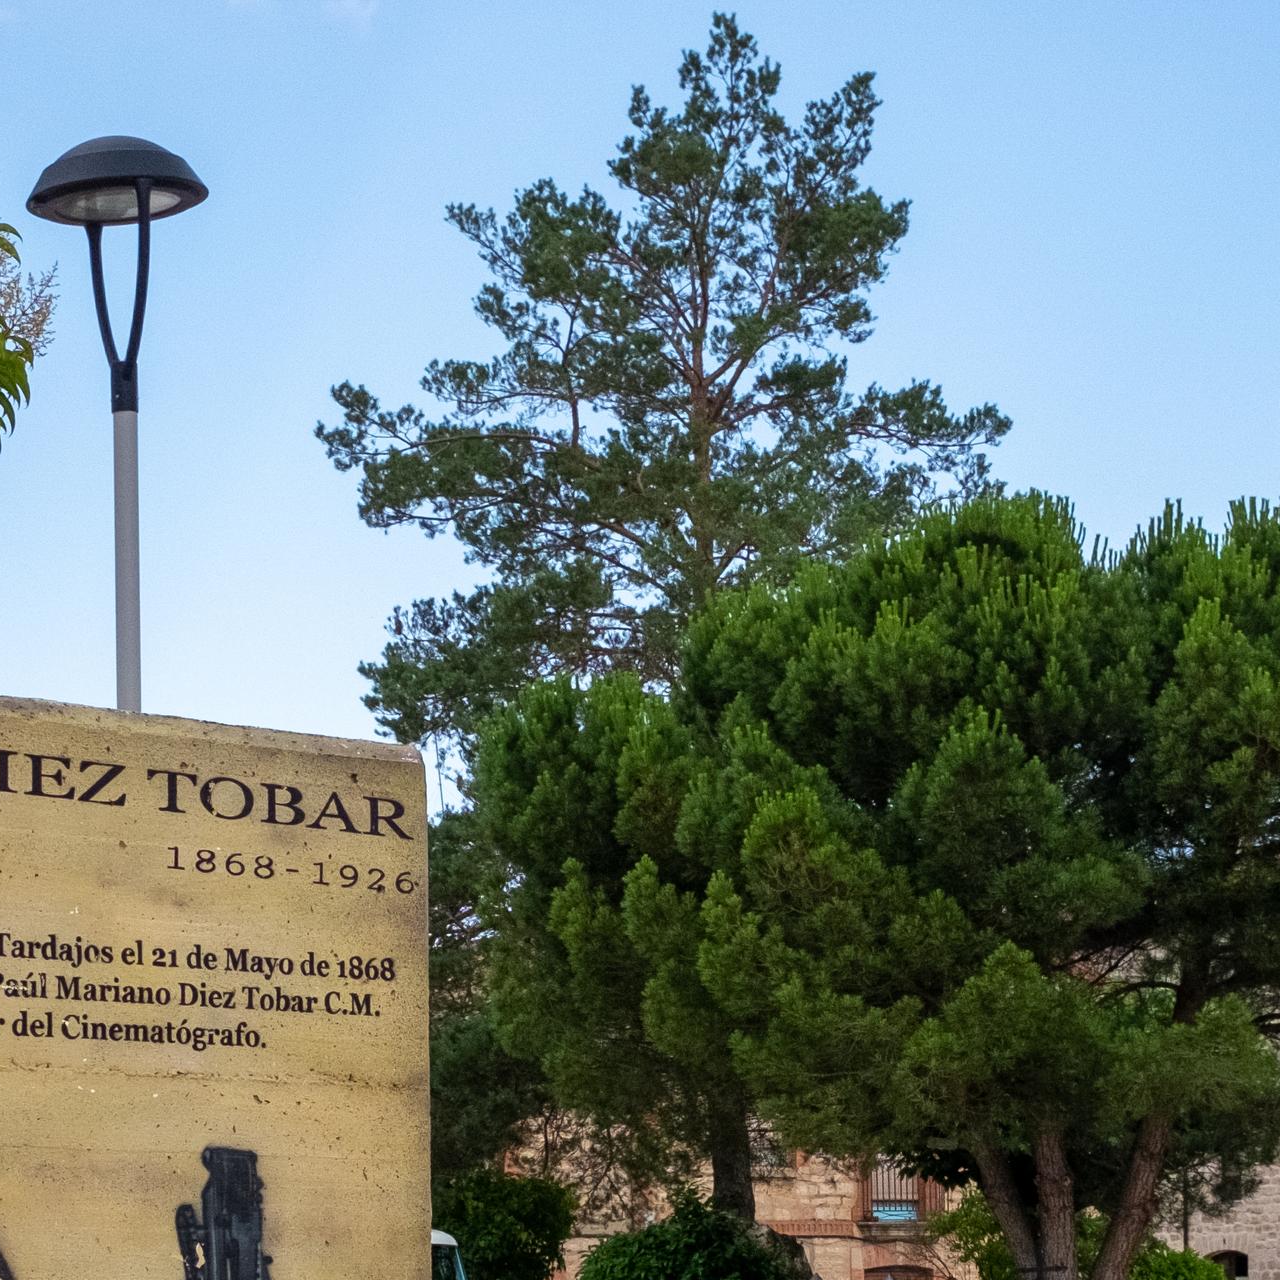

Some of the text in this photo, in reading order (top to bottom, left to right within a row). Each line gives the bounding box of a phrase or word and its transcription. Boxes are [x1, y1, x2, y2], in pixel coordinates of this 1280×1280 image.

[147, 769, 414, 840] TOBAR
[167, 847, 414, 894] 1868-1926
[121, 940, 144, 965] el
[152, 948, 178, 968] 21
[186, 944, 217, 970] de
[224, 948, 294, 980] Mayo
[300, 952, 330, 977] de
[337, 955, 396, 981] 1868
[55, 977, 170, 1005] Mariano
[178, 982, 236, 1009] Diez
[242, 986, 318, 1013] Tobar
[324, 991, 381, 1017] C.M.
[12, 1011, 53, 1037] del
[61, 1014, 266, 1051] Cinematógrafo.
